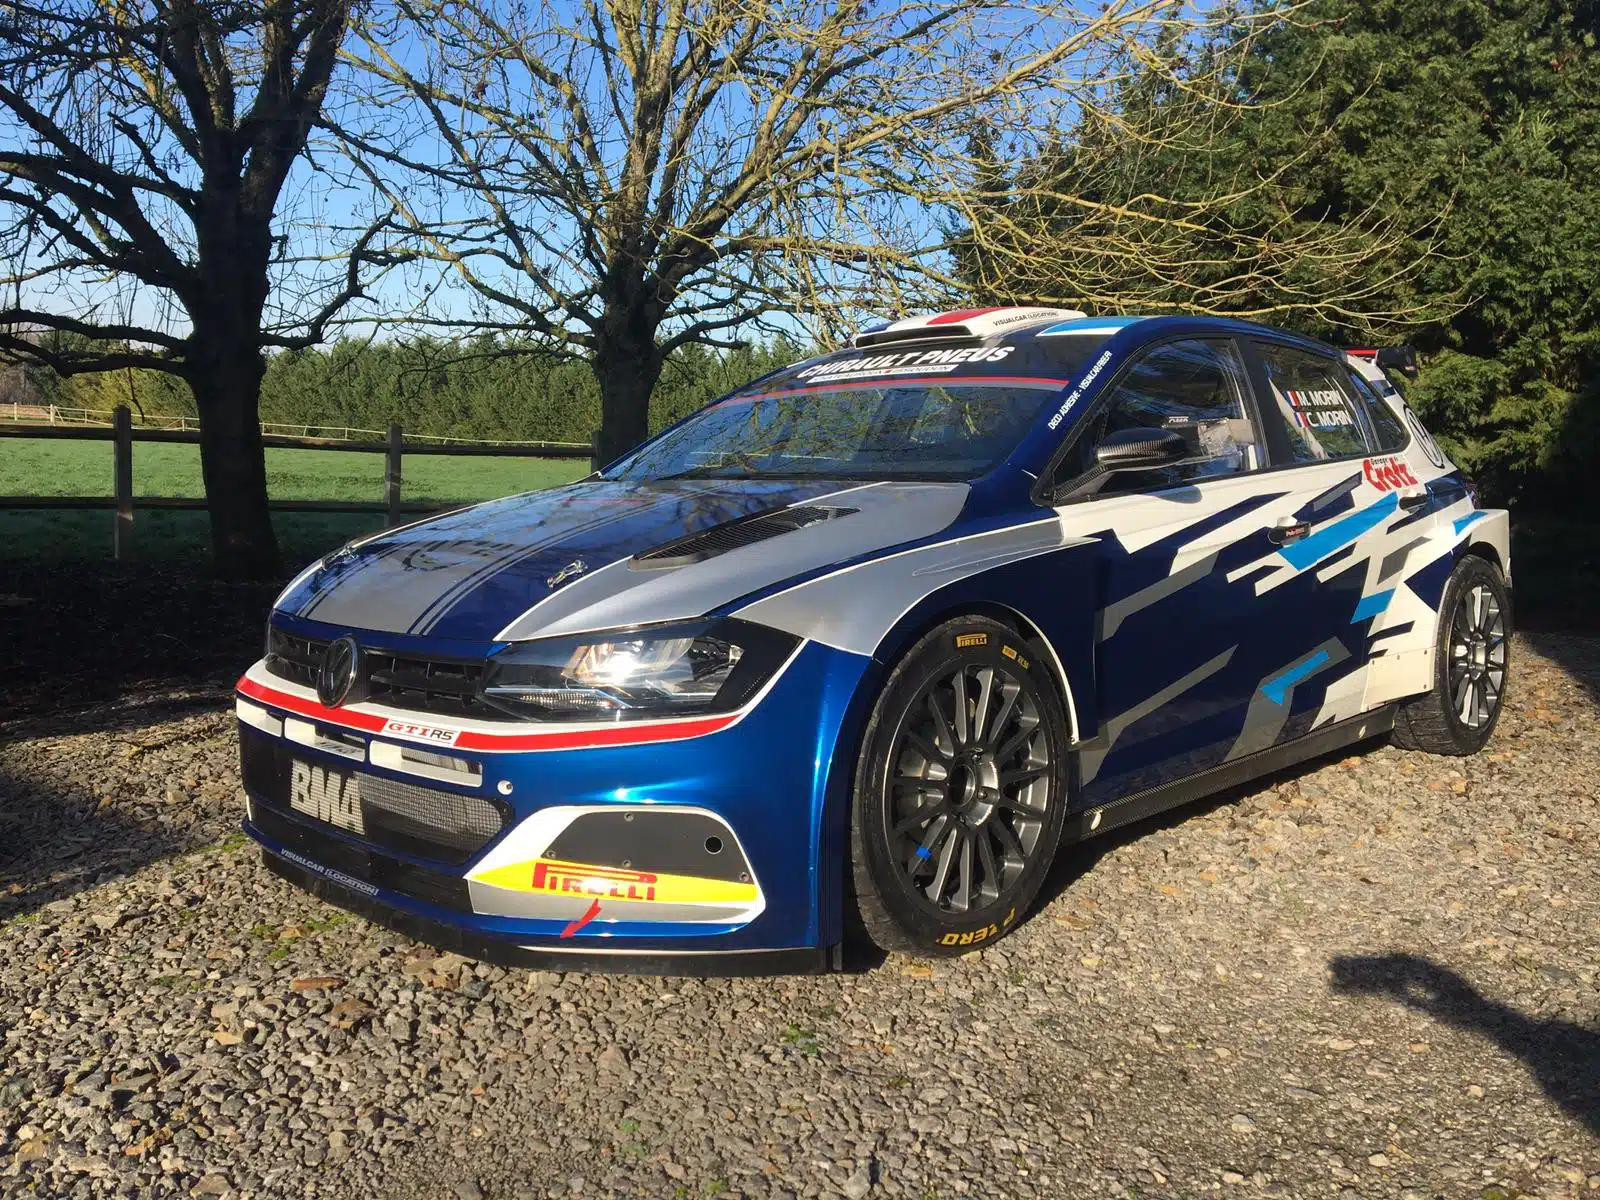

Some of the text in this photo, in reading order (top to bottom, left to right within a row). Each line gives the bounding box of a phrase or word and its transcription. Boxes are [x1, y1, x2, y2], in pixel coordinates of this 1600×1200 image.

[993, 314, 1027, 326] VISUALCAR
[797, 352, 922, 378] CHIRAULT
[912, 346, 1015, 365] PNEUS
[1295, 390, 1344, 407] M. MORIN
[1316, 410, 1353, 426] MORIN
[956, 633, 987, 649] PIRELLI
[290, 758, 366, 835] BMA
[281, 848, 324, 873] VISUALCAR
[532, 862, 657, 901] PIRELLI
